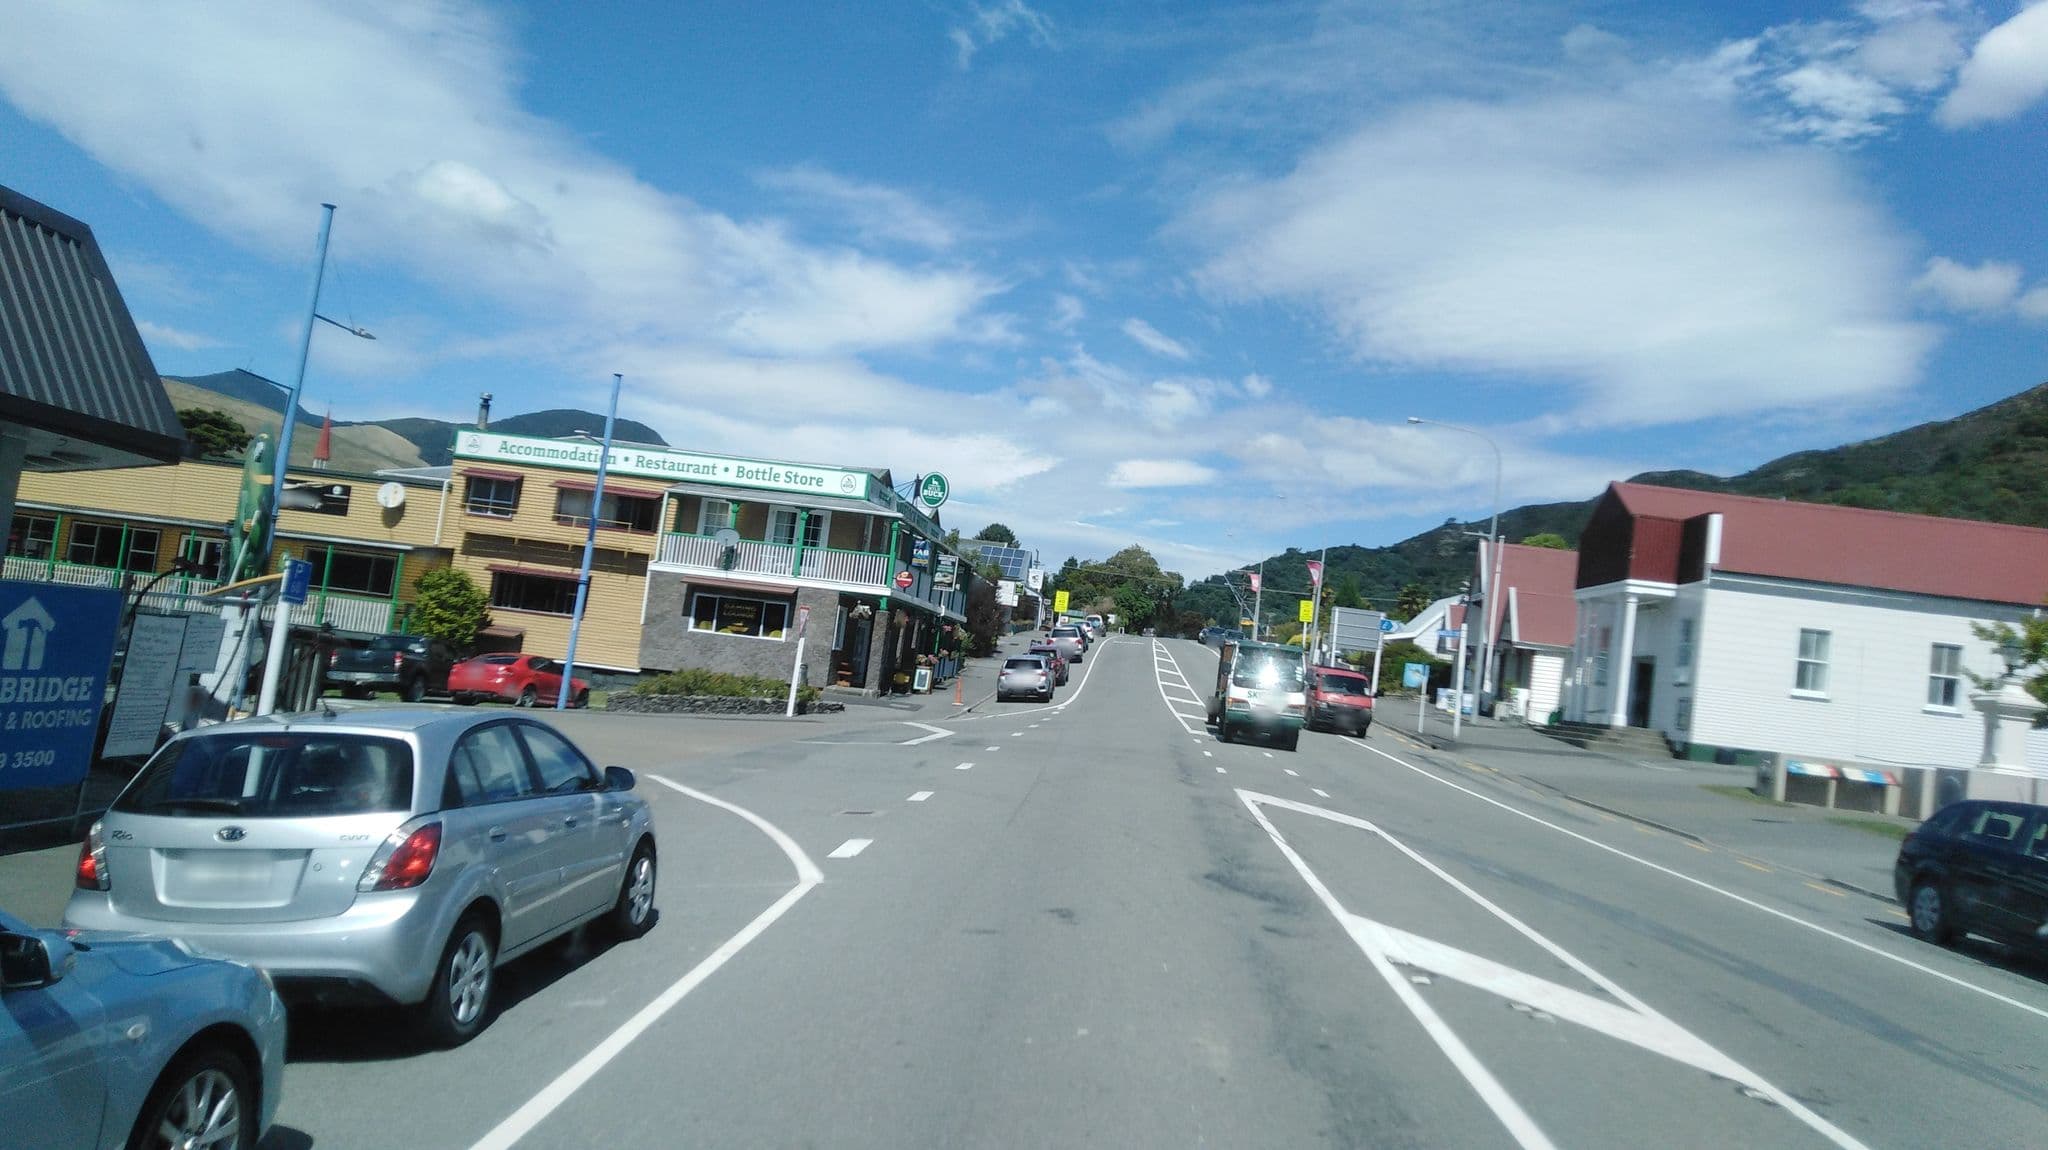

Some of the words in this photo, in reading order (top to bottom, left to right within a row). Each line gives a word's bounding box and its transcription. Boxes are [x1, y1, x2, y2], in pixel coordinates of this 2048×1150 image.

[498, 440, 617, 465] Accommodatin
[634, 455, 718, 476] Restaurant
[735, 466, 781, 482] Bottle
[783, 470, 824, 487] Store
[923, 489, 945, 498] BUCK
[21, 708, 93, 730] ROOFING
[10, 750, 57, 769] 3500
[111, 830, 134, 842] Rio
